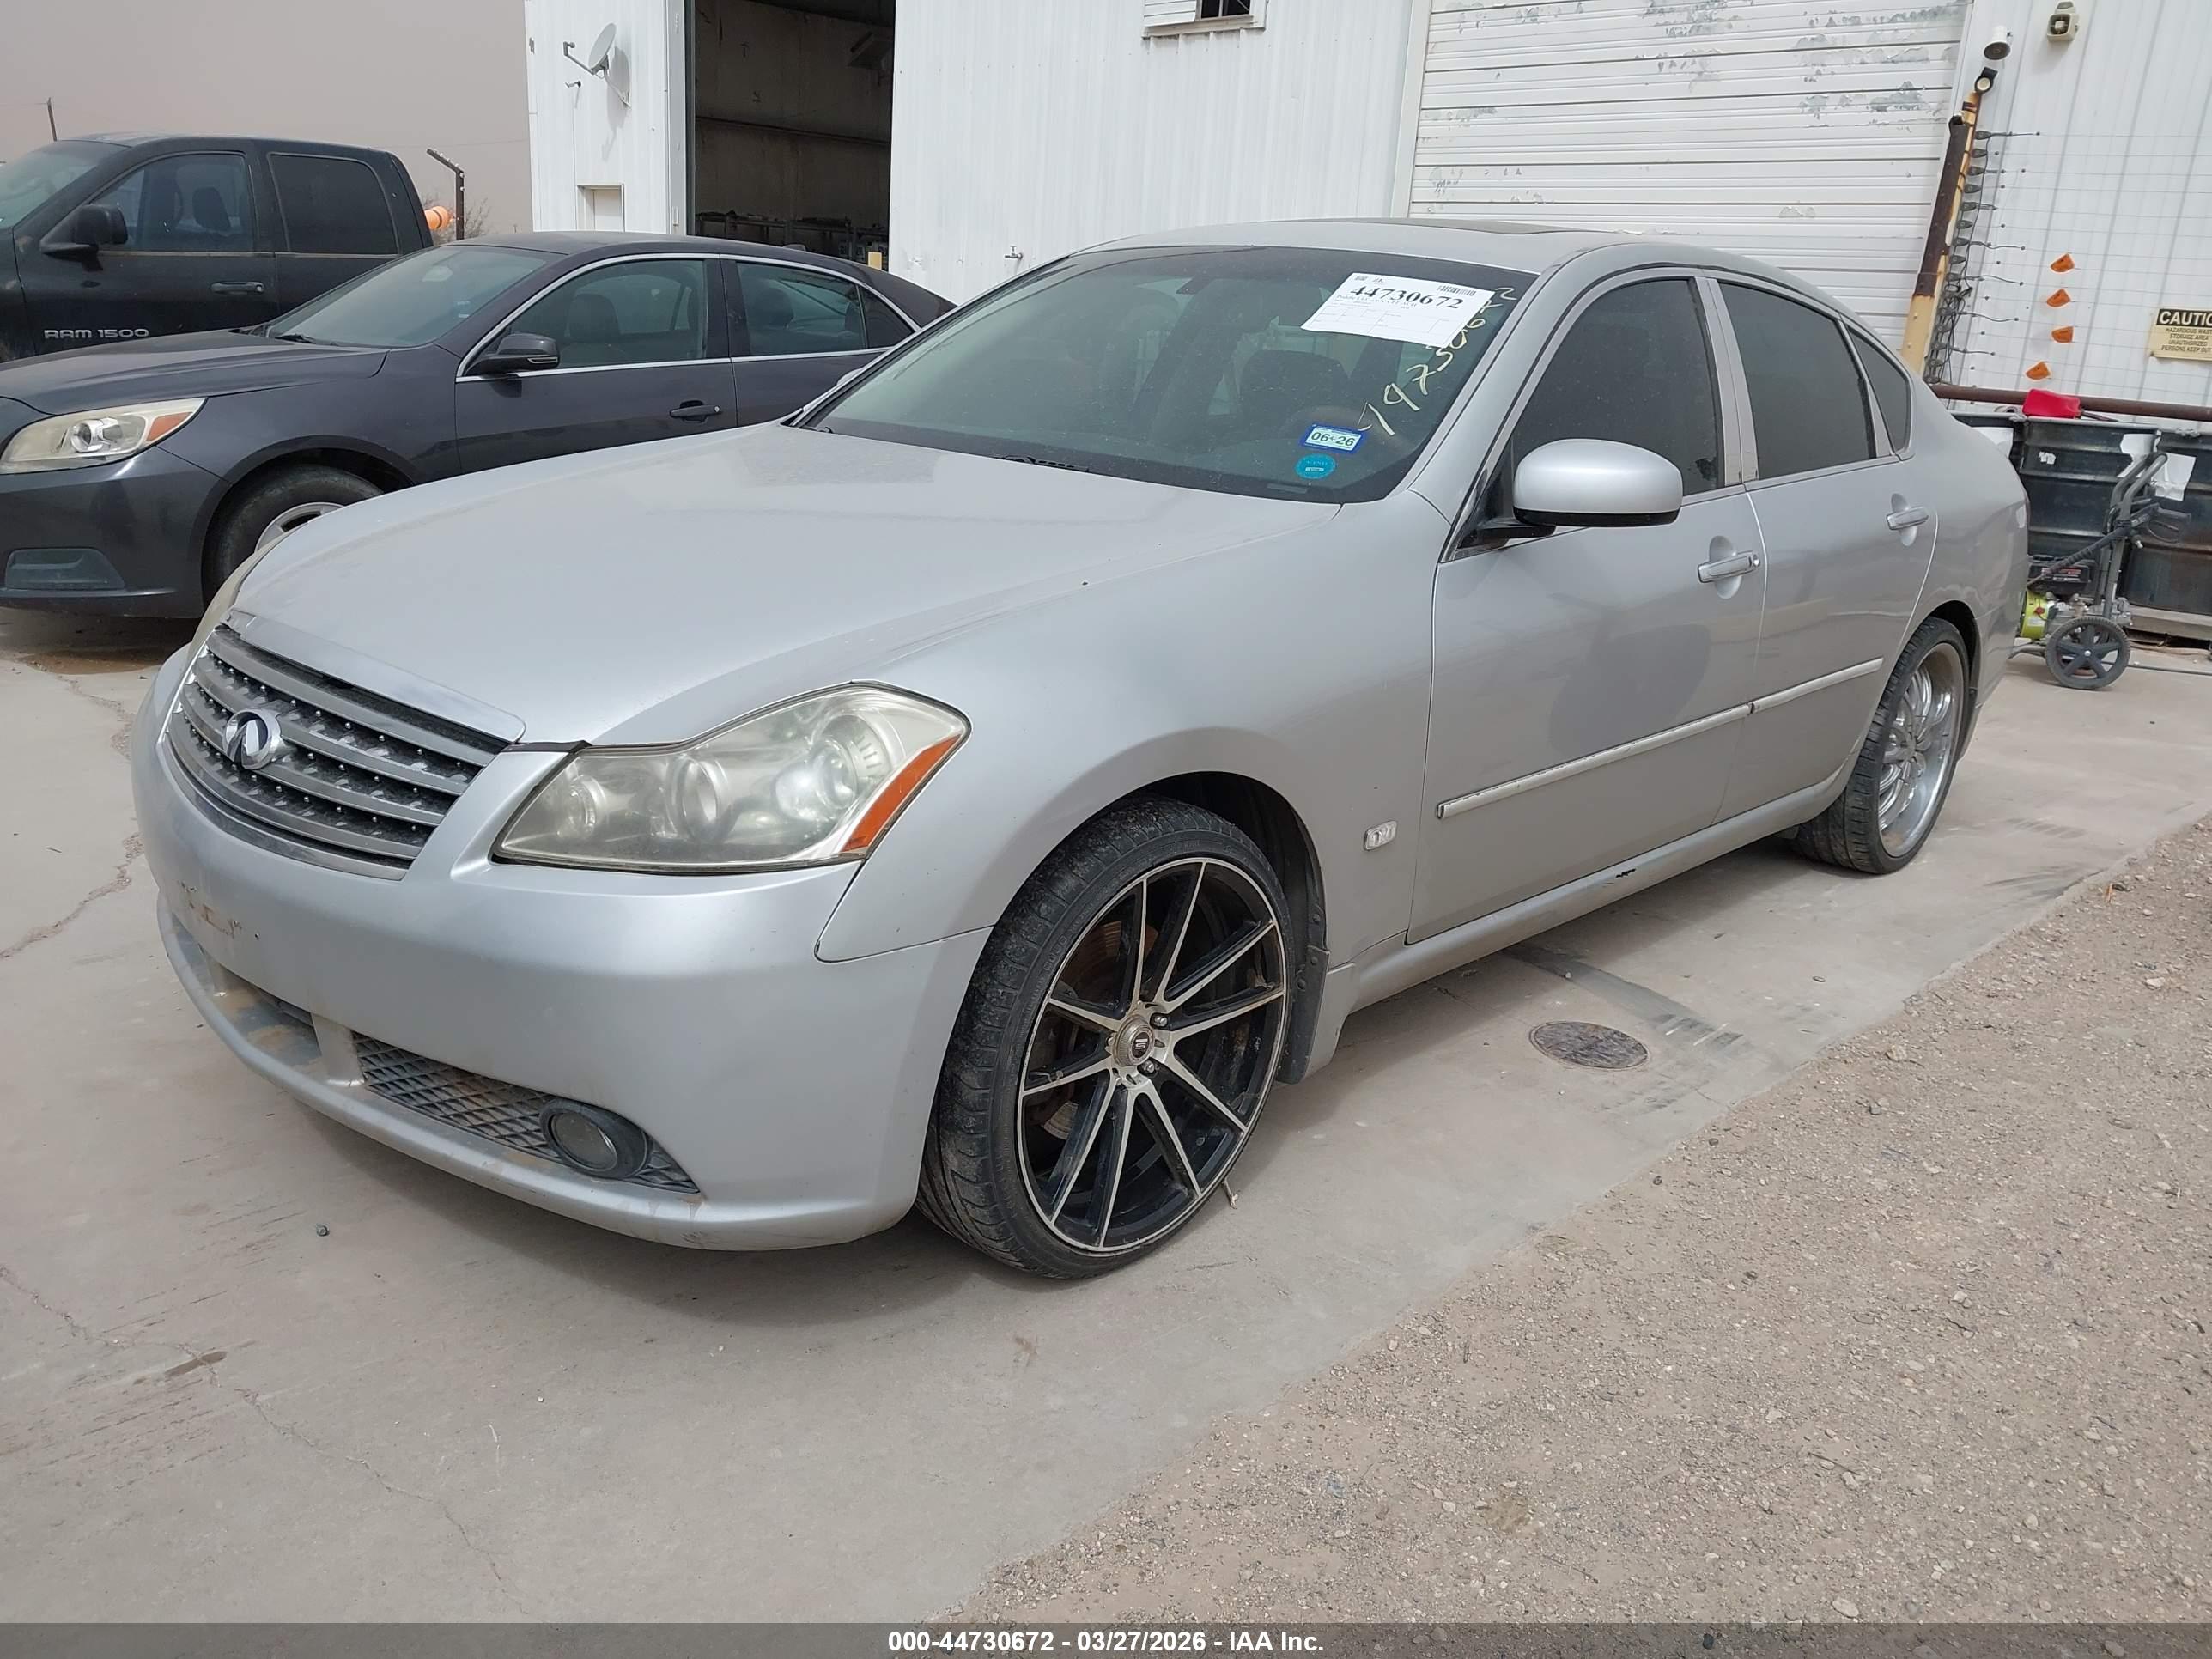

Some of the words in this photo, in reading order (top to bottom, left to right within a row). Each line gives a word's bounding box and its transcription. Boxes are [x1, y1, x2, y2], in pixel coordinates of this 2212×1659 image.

[1349, 285, 1464, 309] 44730672
[44, 329, 92, 339] RAM
[97, 328, 149, 338] 1500
